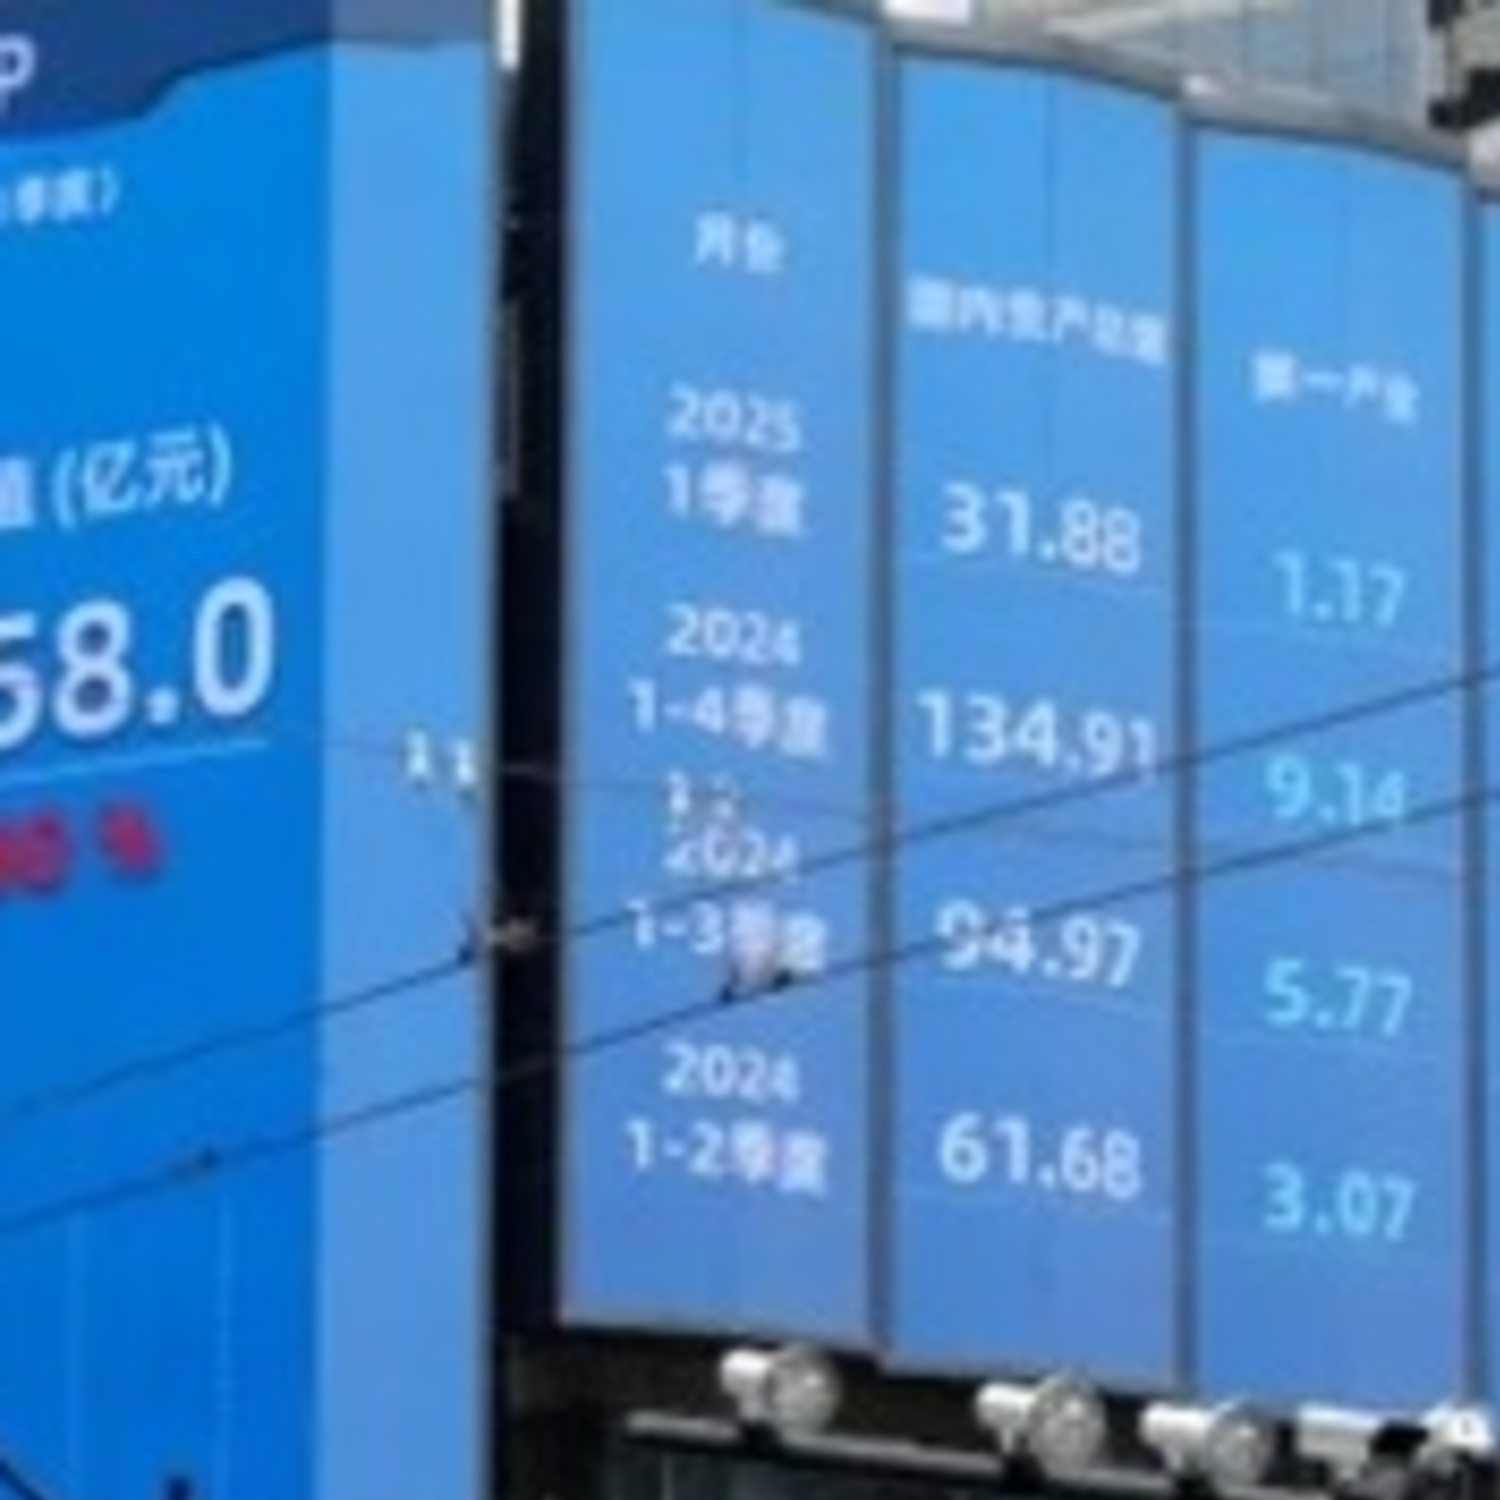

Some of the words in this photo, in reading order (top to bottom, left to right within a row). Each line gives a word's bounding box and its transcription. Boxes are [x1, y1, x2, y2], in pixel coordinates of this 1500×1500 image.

[666, 384, 803, 454] 2025
[940, 482, 1143, 574] 31.88
[1272, 551, 1407, 629] 1.17
[665, 602, 802, 665] 2024
[916, 688, 1158, 784] 134.91
[1265, 754, 1408, 826] 9.14
[934, 899, 1143, 988] 94.97
[1262, 957, 1413, 1037] 5.77
[661, 1043, 801, 1102] 2024
[937, 1112, 1144, 1201] 61.68
[1261, 1163, 1417, 1240] 3.07
